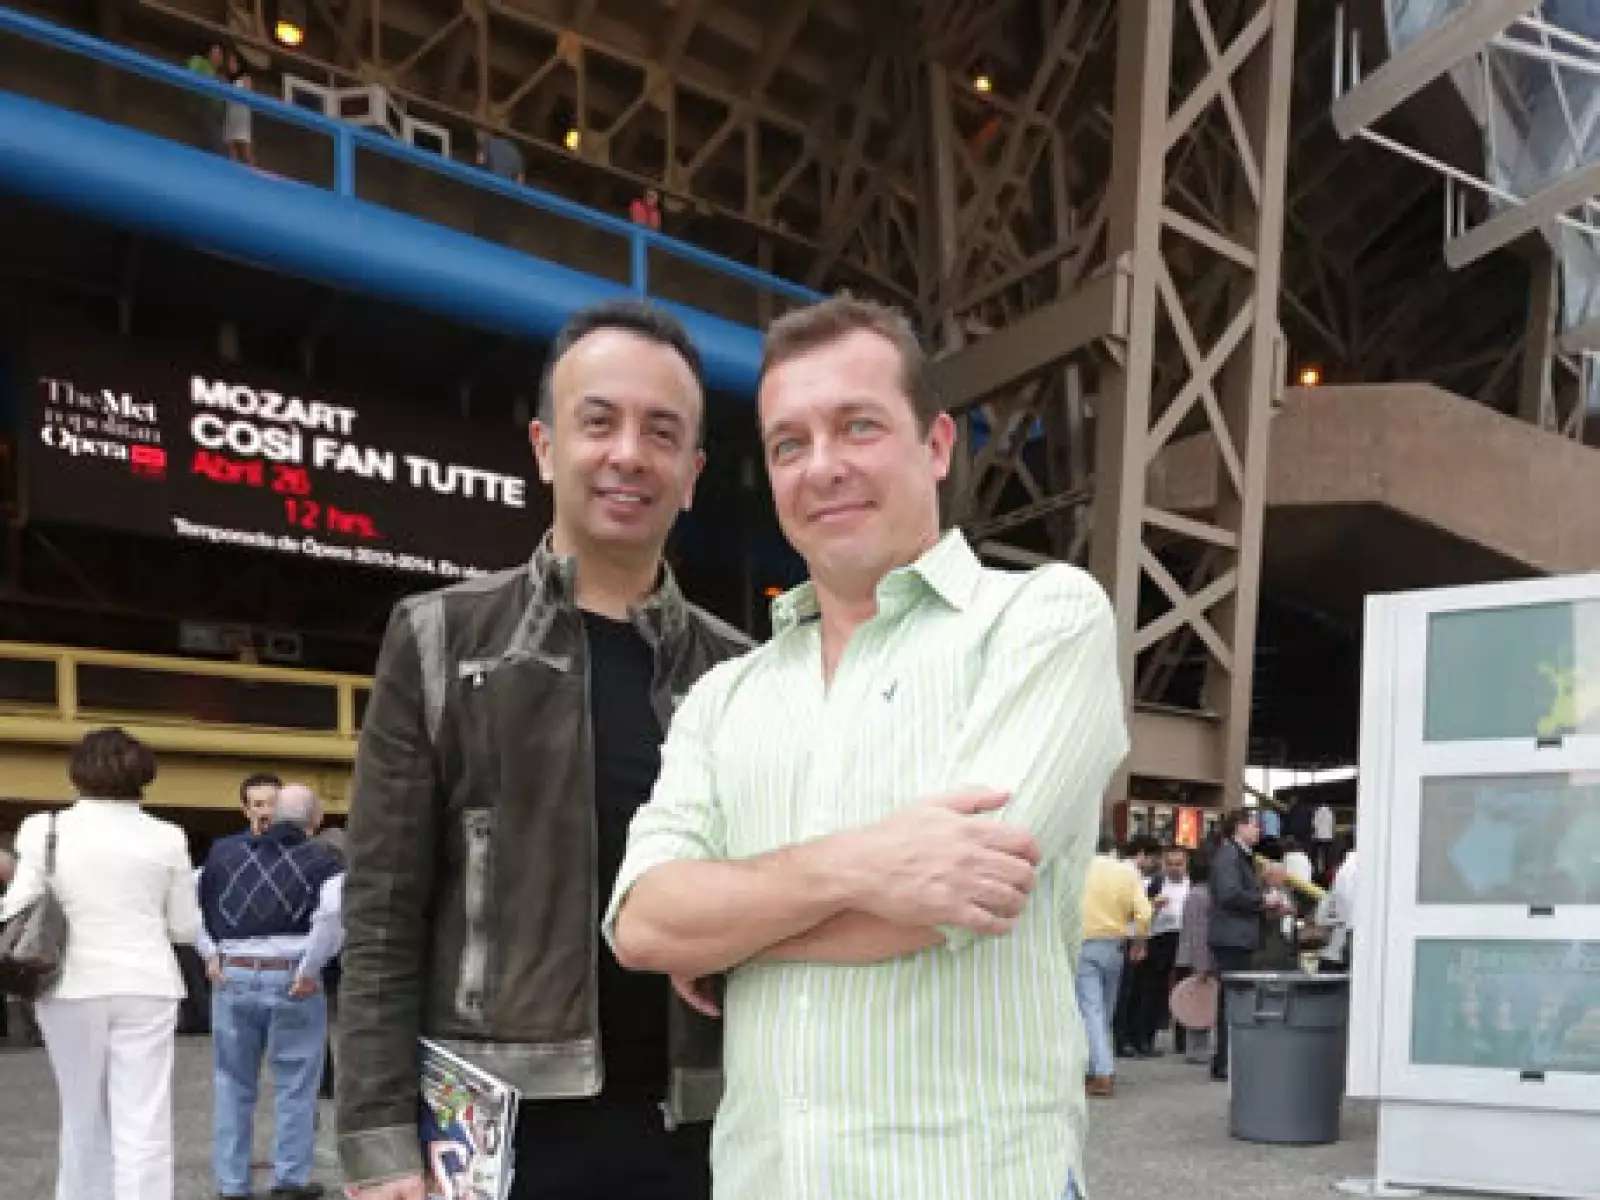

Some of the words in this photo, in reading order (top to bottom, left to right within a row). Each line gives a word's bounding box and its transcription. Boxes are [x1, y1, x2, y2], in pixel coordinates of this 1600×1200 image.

[39, 376, 98, 409] The
[101, 388, 158, 424] Met
[191, 375, 358, 435] MOZART
[41, 426, 129, 460] Opera
[191, 413, 303, 464] COSÌ
[313, 436, 396, 484] FAN
[403, 455, 526, 508] TUTTE
[285, 497, 321, 530] 12
[278, 535, 300, 553] de
